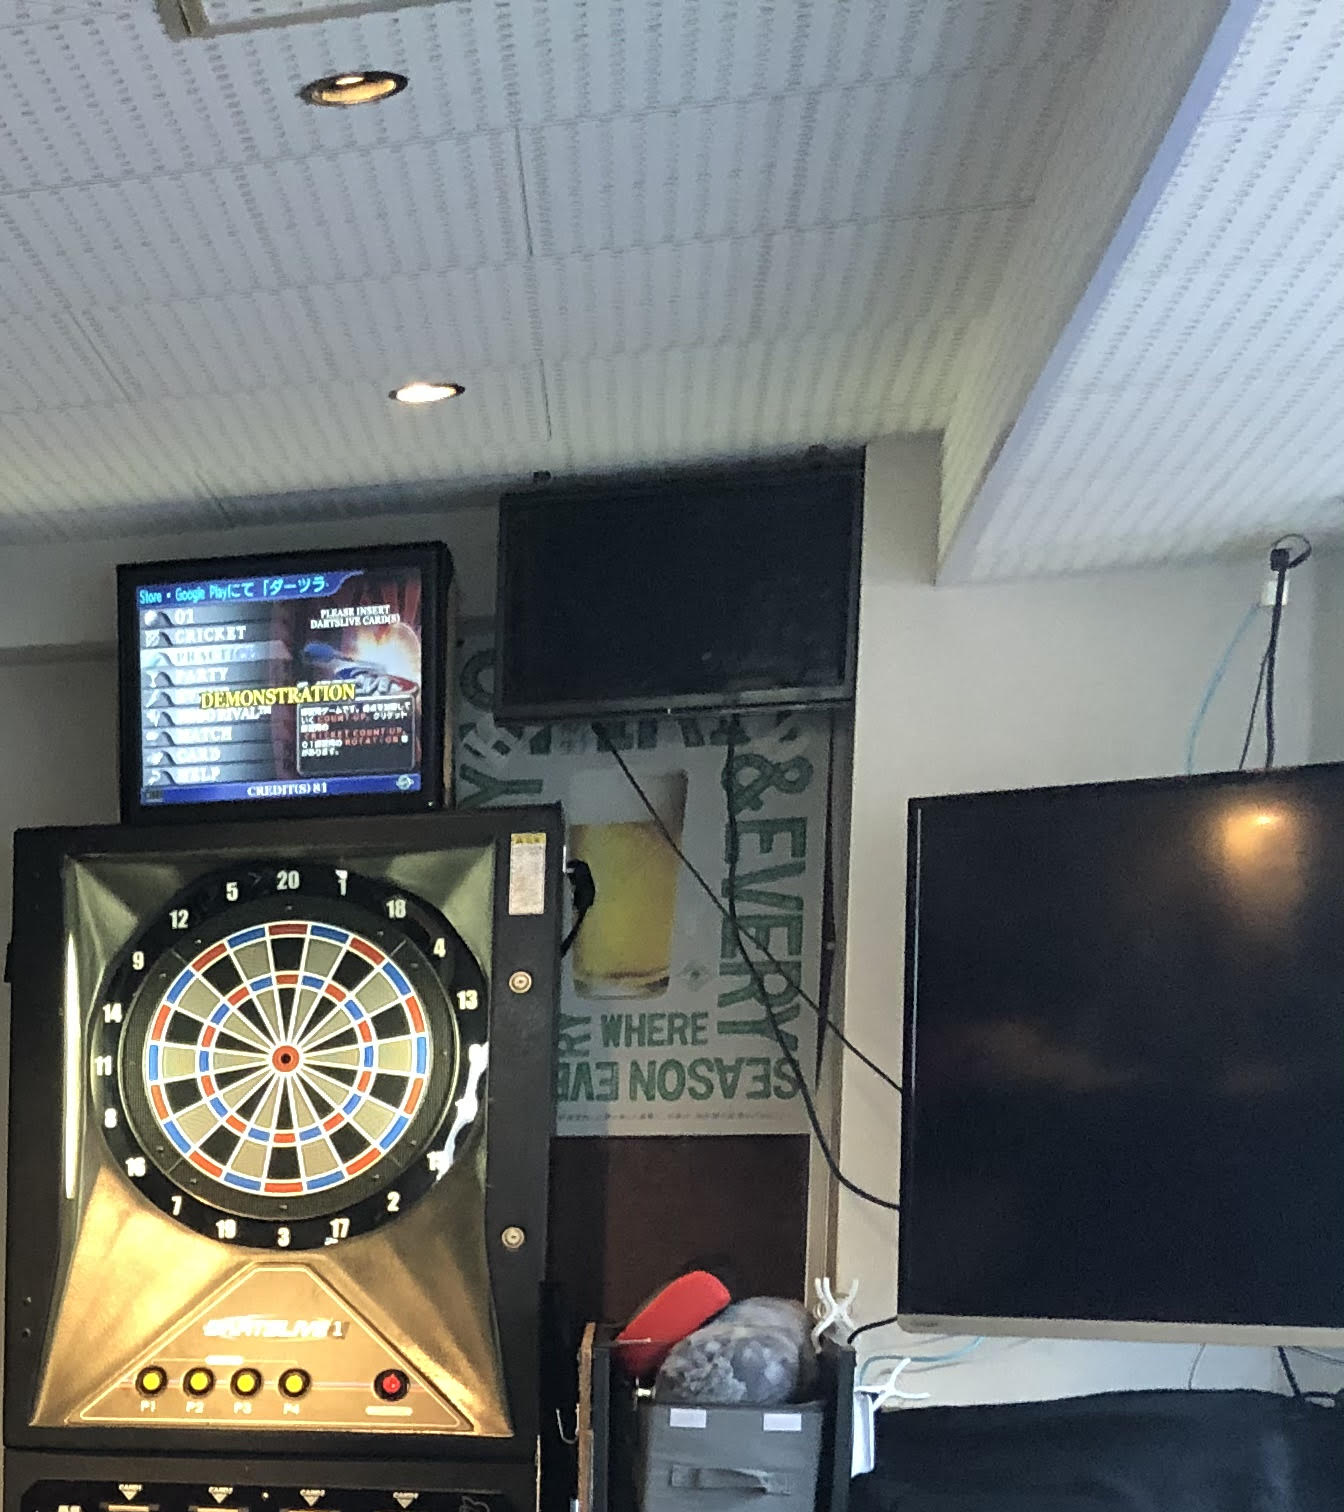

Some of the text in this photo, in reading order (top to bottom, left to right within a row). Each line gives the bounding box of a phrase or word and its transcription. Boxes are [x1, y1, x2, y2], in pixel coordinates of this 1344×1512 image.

[175, 587, 205, 603] Google
[263, 576, 329, 597] 「ダーツラ
[174, 608, 194, 625] 01
[320, 604, 390, 619] PLEASE INSERT
[310, 616, 361, 629] DARTSLIVE
[175, 626, 247, 642] CRICKET
[201, 683, 356, 710] DEMONSTRATION
[721, 754, 814, 814] &
[278, 870, 300, 890] 20
[226, 882, 238, 901] 5
[169, 909, 189, 929] 12
[386, 899, 407, 919] 18
[717, 816, 808, 1050] EVERY
[433, 938, 446, 958] 4
[132, 951, 145, 970] 9
[457, 990, 478, 1010] 13
[103, 1004, 123, 1023] 14
[601, 1011, 709, 1048] WHERE
[94, 1056, 113, 1076] 11
[629, 1057, 799, 1101] SEASON
[104, 1108, 117, 1128] 8
[171, 1196, 183, 1215] 7
[387, 1191, 400, 1211] 2
[216, 1219, 237, 1239] 19
[277, 1227, 290, 1247] 3
[330, 1218, 351, 1239] 17
[140, 1400, 157, 1412] P1
[185, 1402, 204, 1413] P2
[233, 1402, 252, 1414] P3
[282, 1403, 300, 1415] P4
